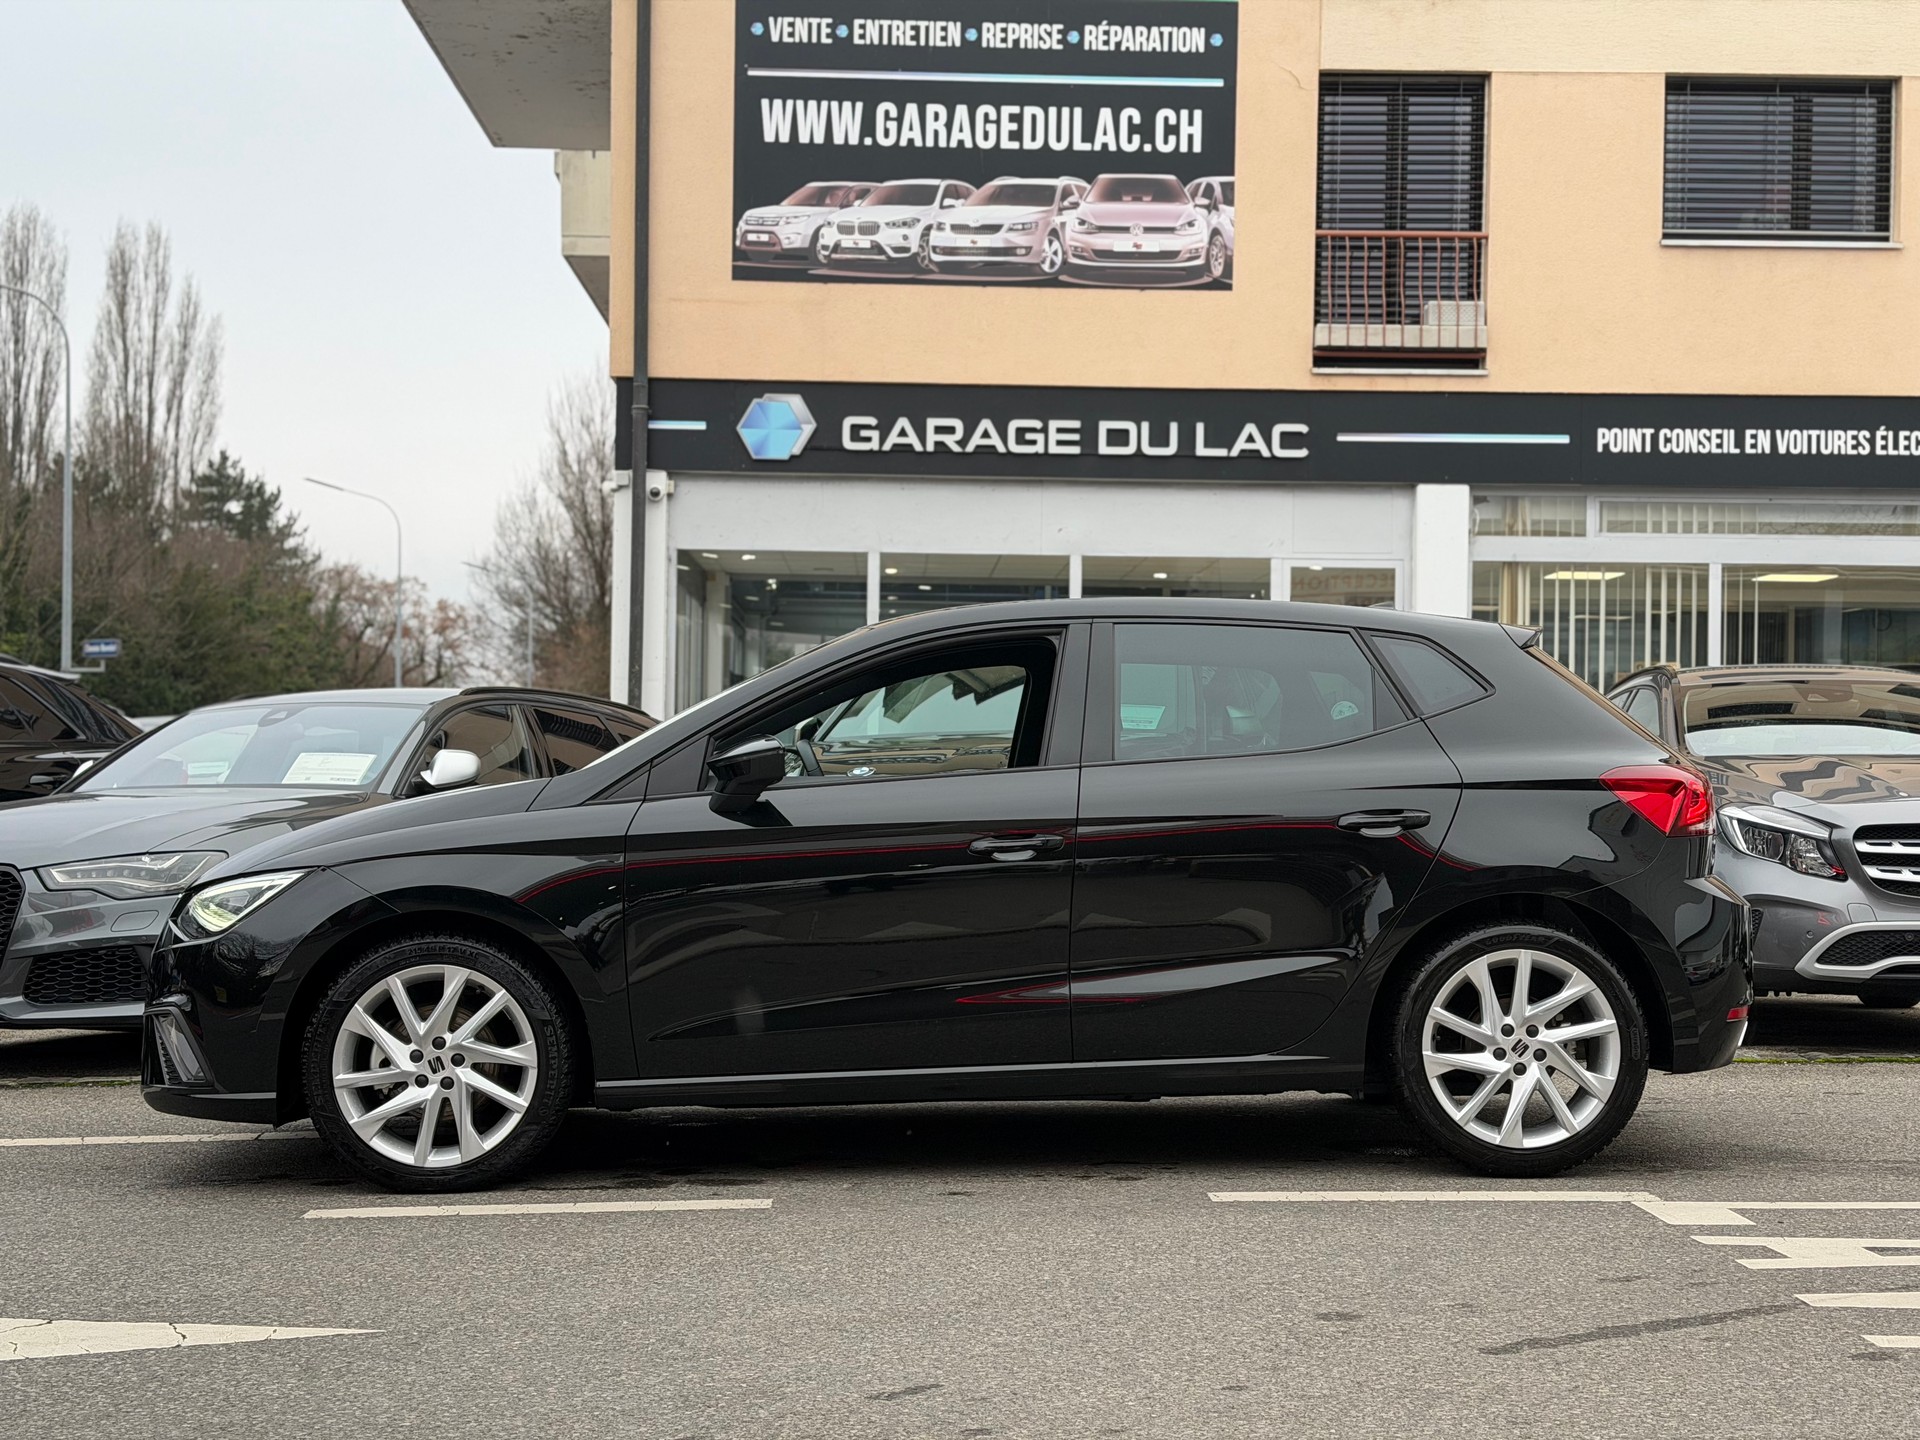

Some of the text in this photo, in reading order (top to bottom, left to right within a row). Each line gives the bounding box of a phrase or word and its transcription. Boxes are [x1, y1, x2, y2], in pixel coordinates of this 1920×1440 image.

[768, 17, 1206, 53] VENTE ENTRETIEN REPRISE RÉPARATION
[760, 98, 1203, 153] WWW.GARAGEDULAC.CH
[841, 415, 1310, 458] GARAGE DU LAC
[1596, 425, 1920, 456] POINT CONSEIL EN VOITURES ÉLEC
[543, 1024, 559, 1106] SEMPERIT
